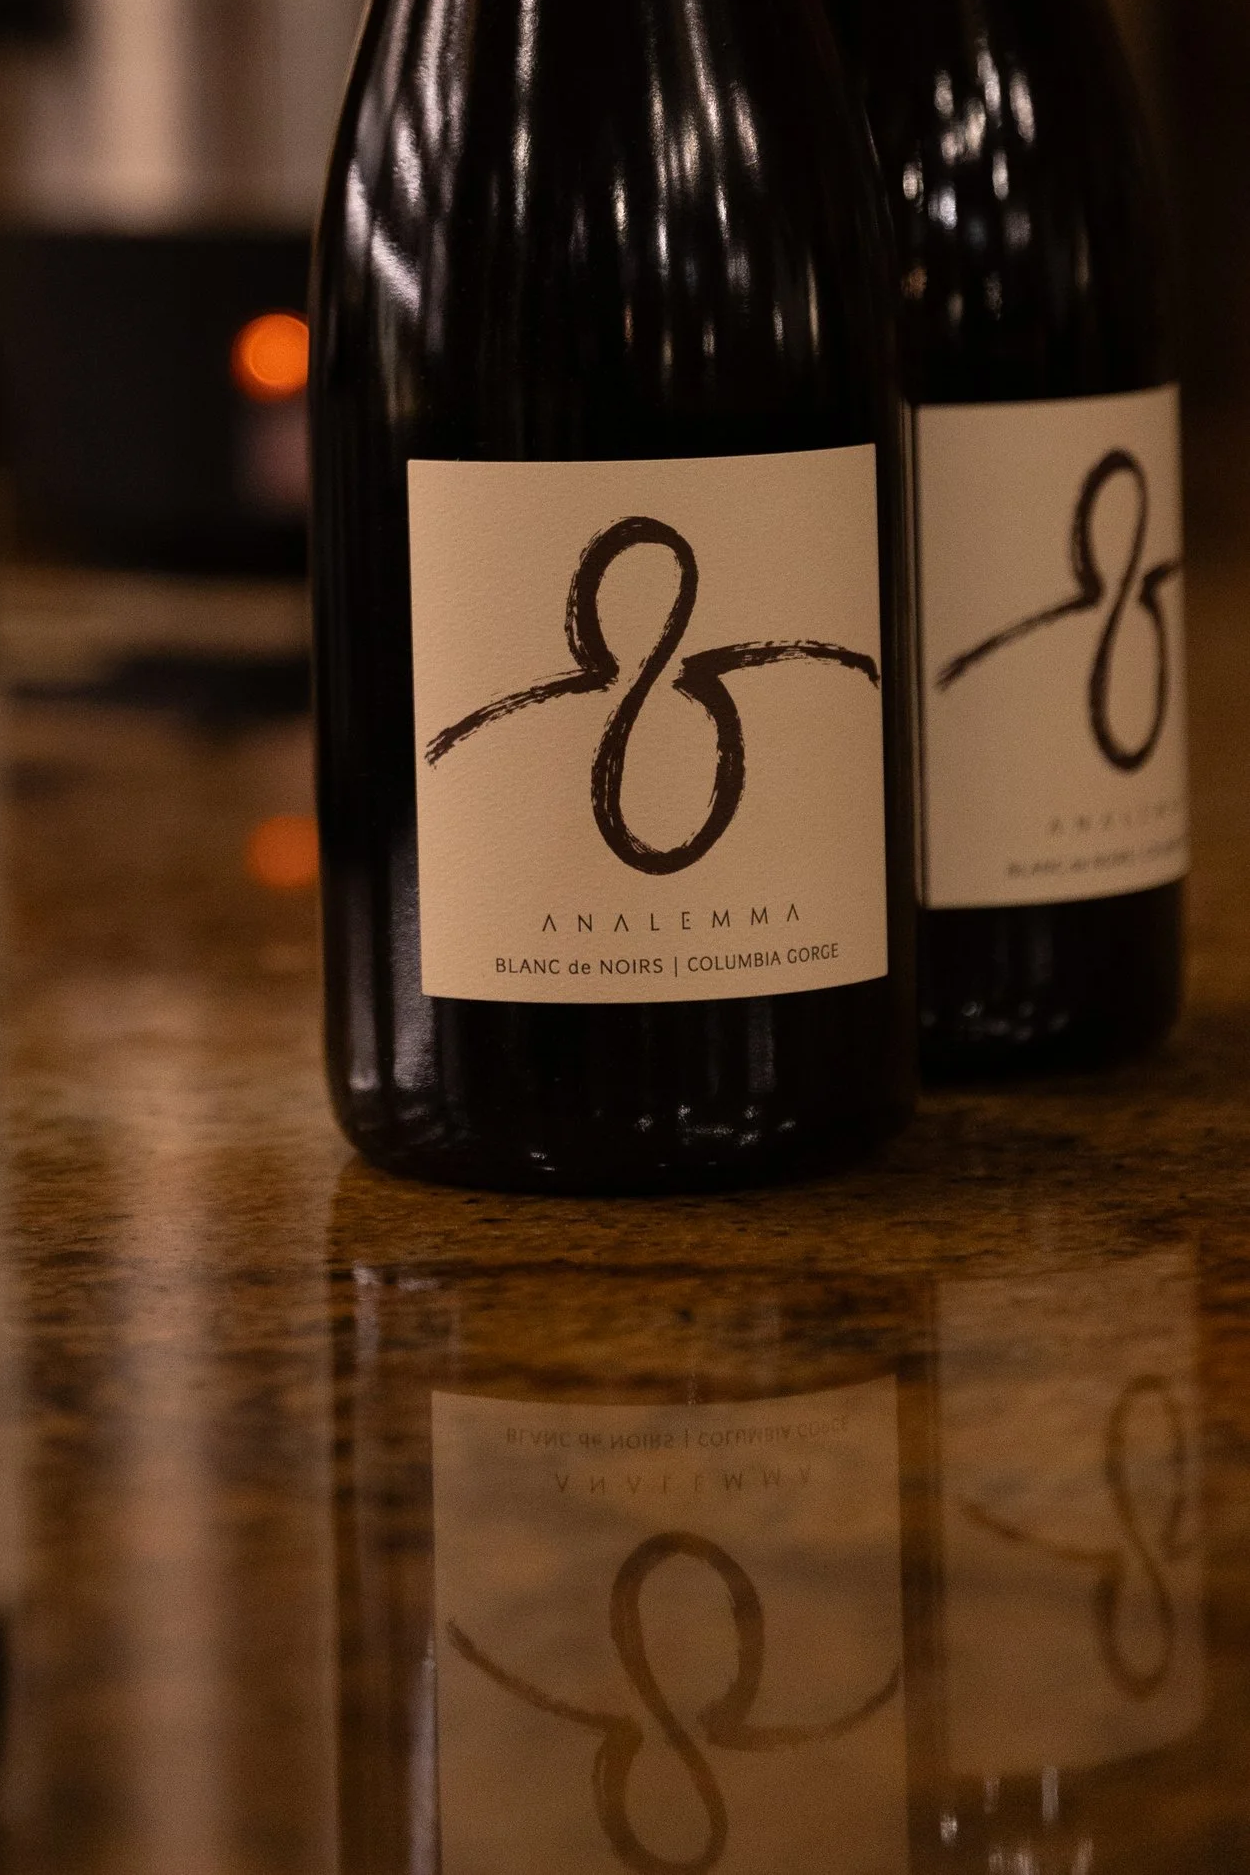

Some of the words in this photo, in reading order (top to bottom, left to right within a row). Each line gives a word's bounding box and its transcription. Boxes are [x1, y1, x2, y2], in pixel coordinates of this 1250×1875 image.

[541, 903, 800, 933] ANALEMMA
[495, 957, 561, 975] BLANC
[568, 959, 592, 975] de
[599, 958, 664, 975] NOIRS
[687, 950, 782, 973] COLUMBIA
[786, 942, 839, 964] GORGE
